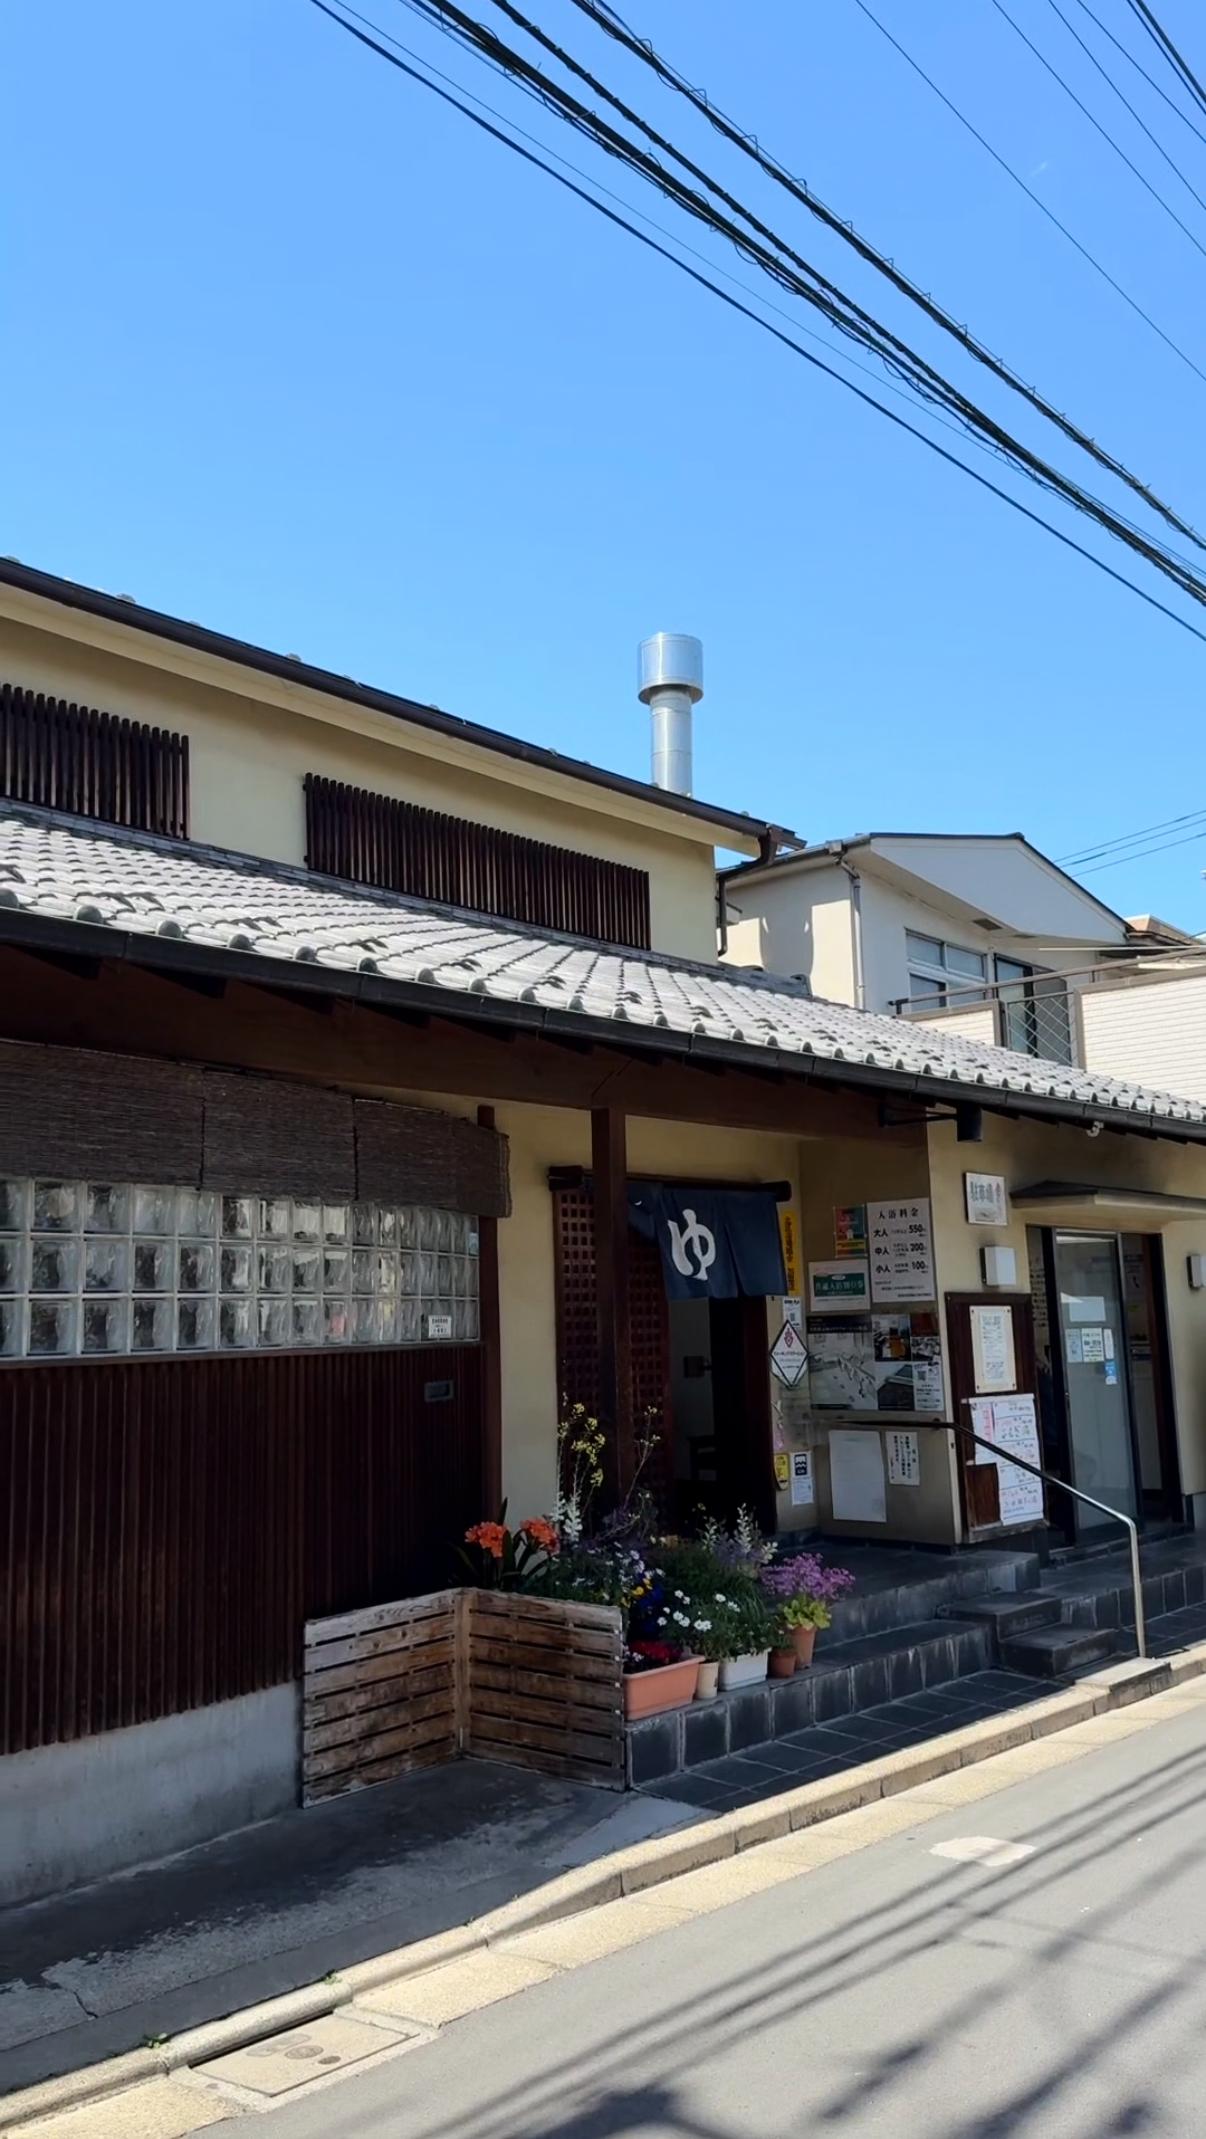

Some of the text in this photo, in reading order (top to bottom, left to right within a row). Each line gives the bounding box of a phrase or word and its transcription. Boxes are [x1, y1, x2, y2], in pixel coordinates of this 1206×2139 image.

[873, 1228, 889, 1238] 大人
[667, 1208, 716, 1281] ゆ
[874, 1246, 890, 1256] 中人
[875, 1264, 891, 1274] 小人
